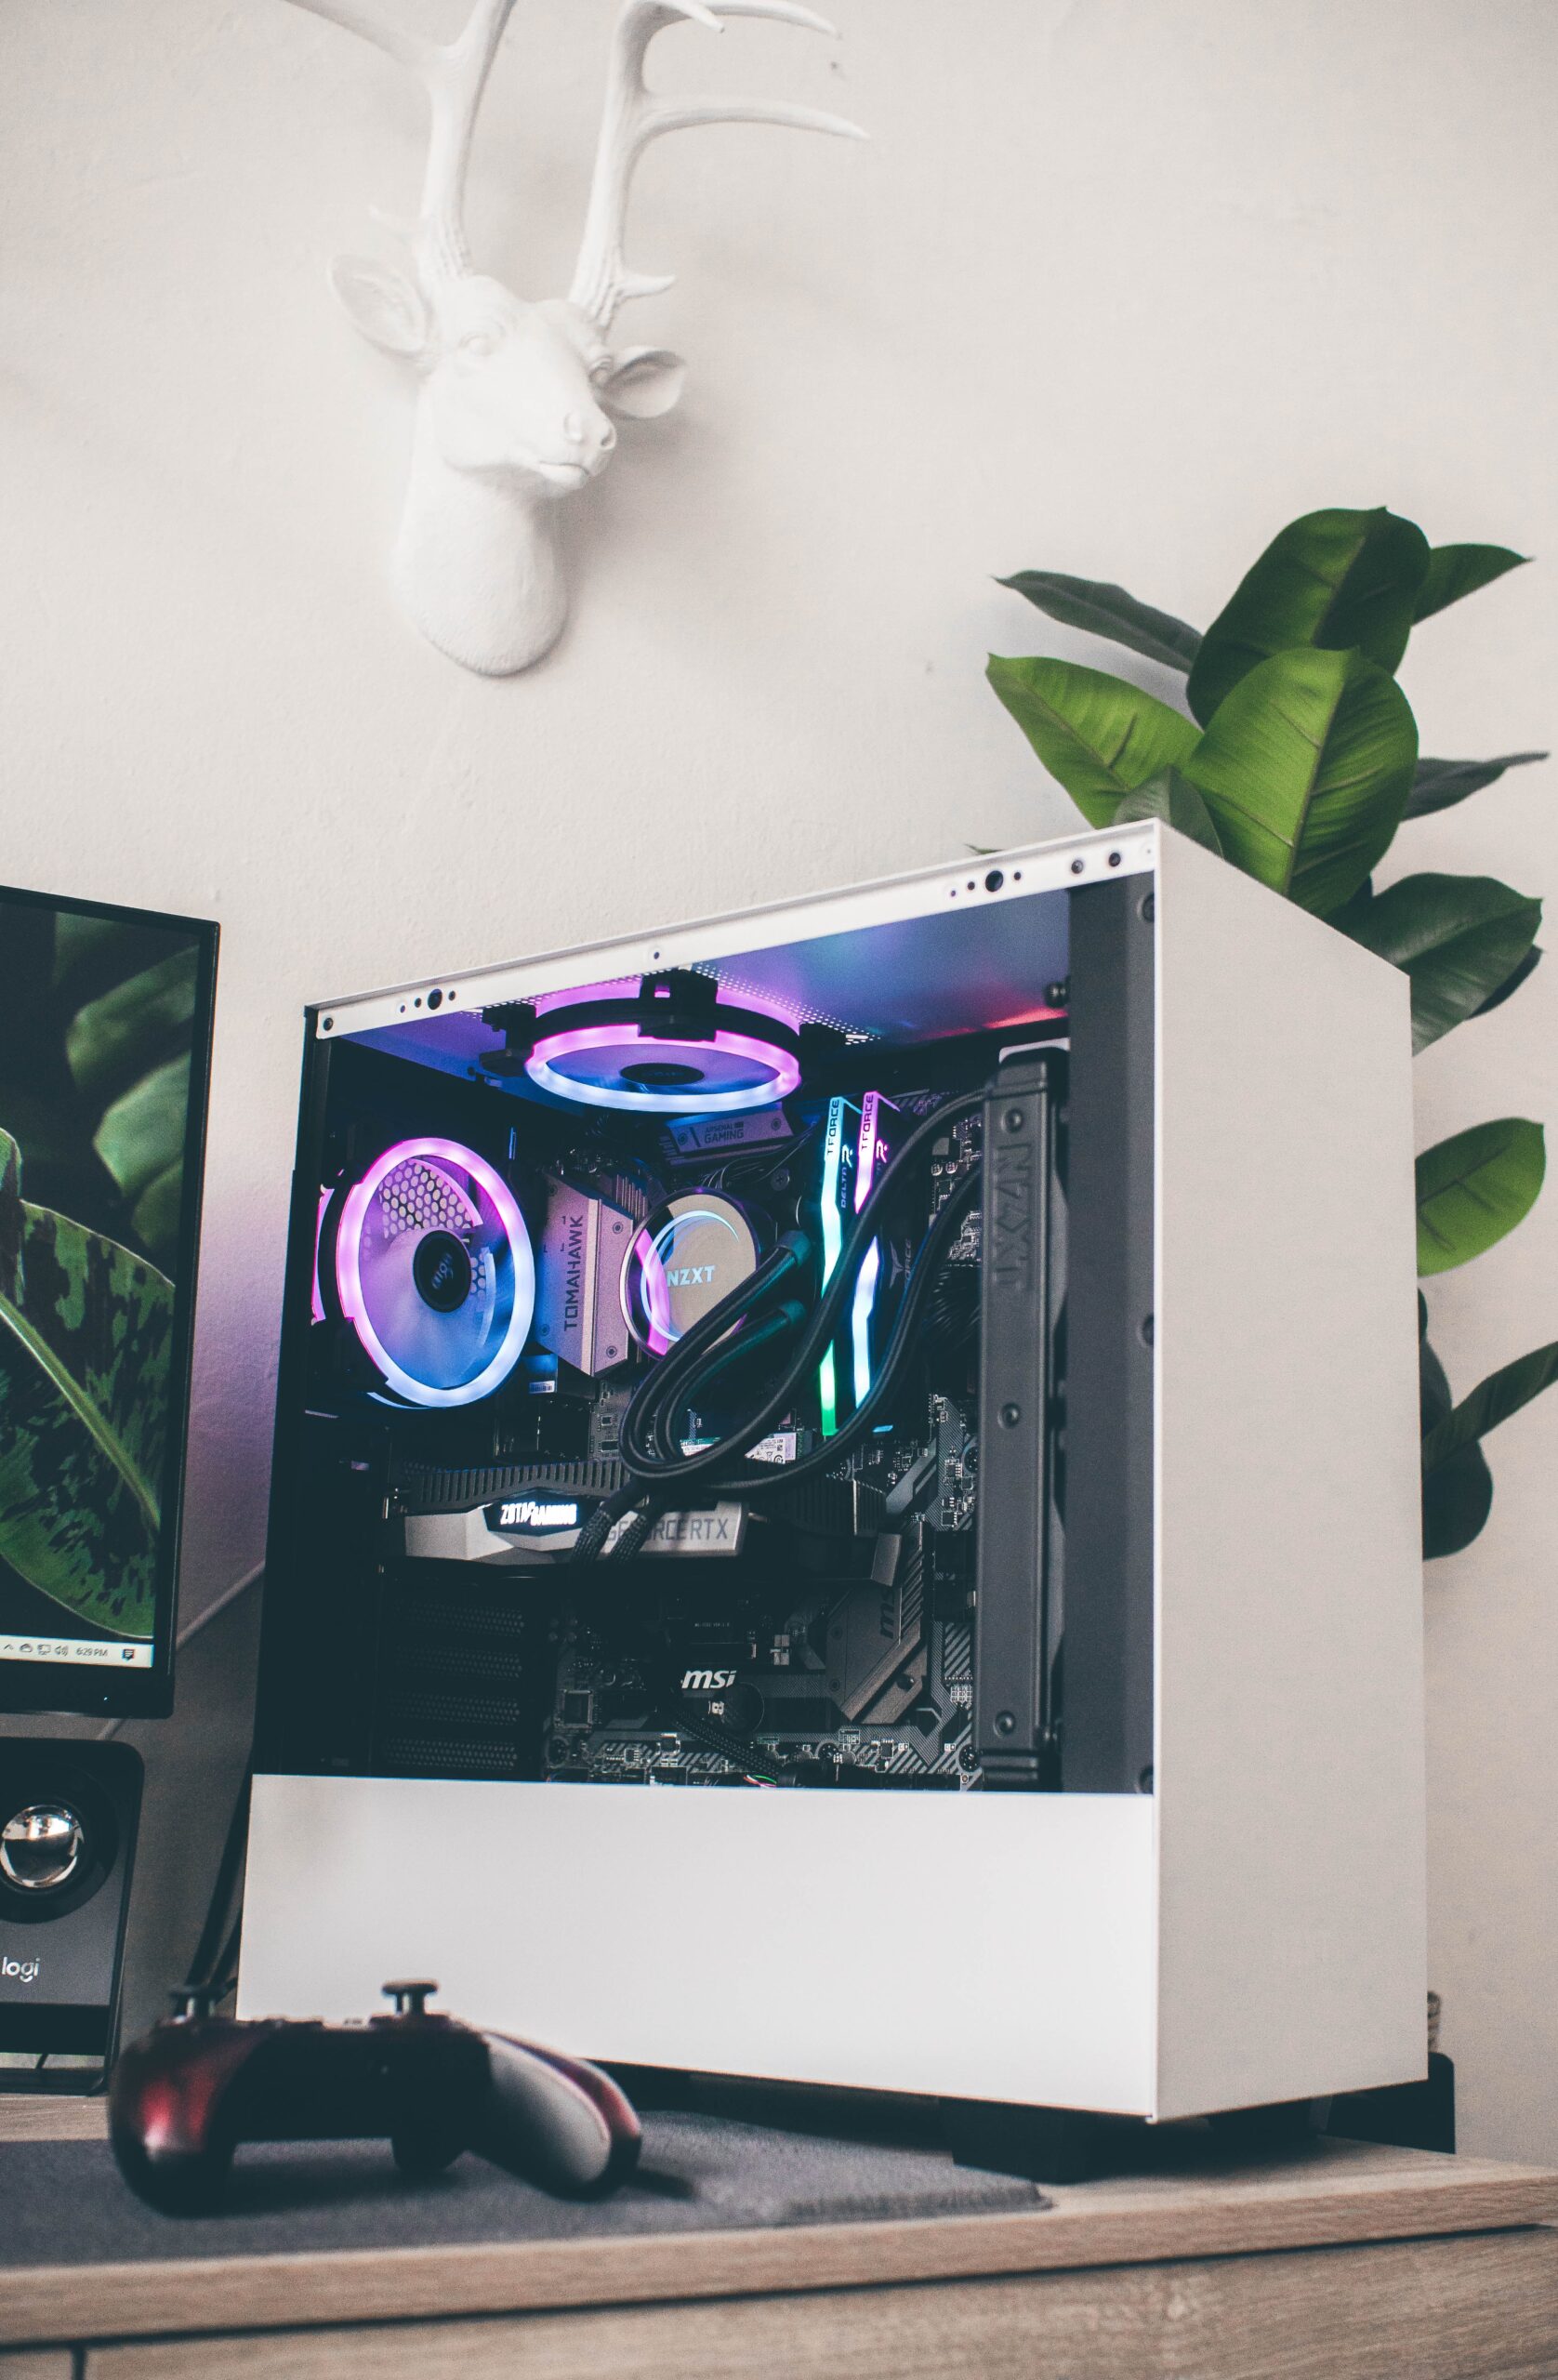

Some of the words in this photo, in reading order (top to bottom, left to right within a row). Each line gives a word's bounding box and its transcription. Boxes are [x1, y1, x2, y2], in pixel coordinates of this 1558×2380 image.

[704, 1129, 744, 1144] GAMING
[563, 1214, 584, 1332] TOMAHAWK
[667, 1264, 715, 1288] NZXT
[690, 1517, 728, 1540] RTX
[680, 1670, 737, 1689] msi
[2, 1956, 41, 1983] logi
